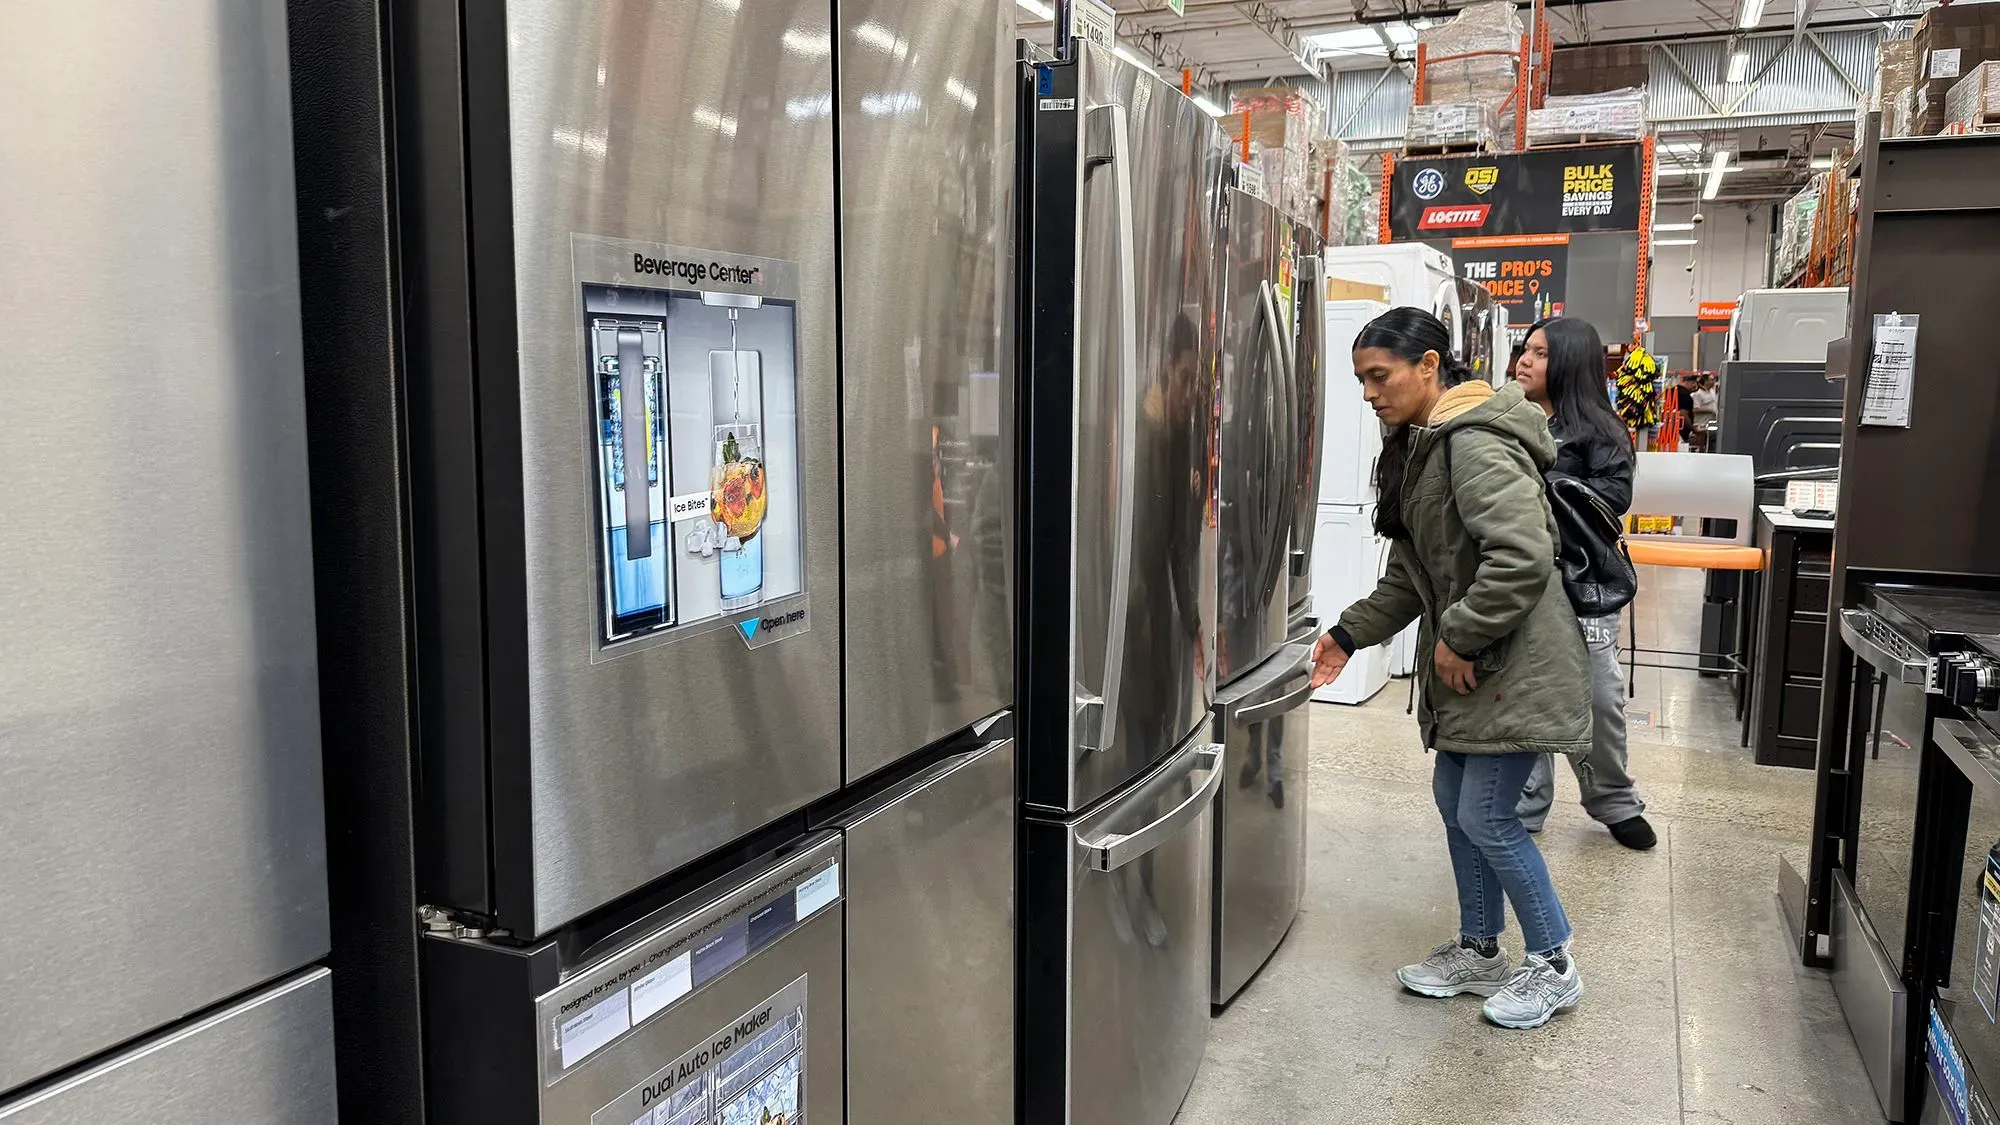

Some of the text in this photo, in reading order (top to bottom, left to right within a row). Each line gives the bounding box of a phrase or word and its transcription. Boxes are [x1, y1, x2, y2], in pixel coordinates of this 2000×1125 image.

[1564, 164, 1614, 180] BULK
[1563, 179, 1614, 193] PRICE
[1563, 191, 1613, 202] SAVINGS
[1562, 206, 1592, 216] EVERY
[1593, 204, 1612, 215] DAY
[634, 253, 706, 285] Beverage
[1464, 259, 1552, 279] THE PRO'S
[1700, 307, 1732, 316] Return
[674, 503, 686, 513] Ice
[762, 609, 805, 633] Open here
[560, 988, 593, 1014] Designed
[594, 985, 603, 997] for
[618, 971, 628, 982] by
[628, 966, 641, 978] you
[648, 936, 689, 963] Changeable
[642, 1006, 773, 1107] Dual Auto Ice Maker
